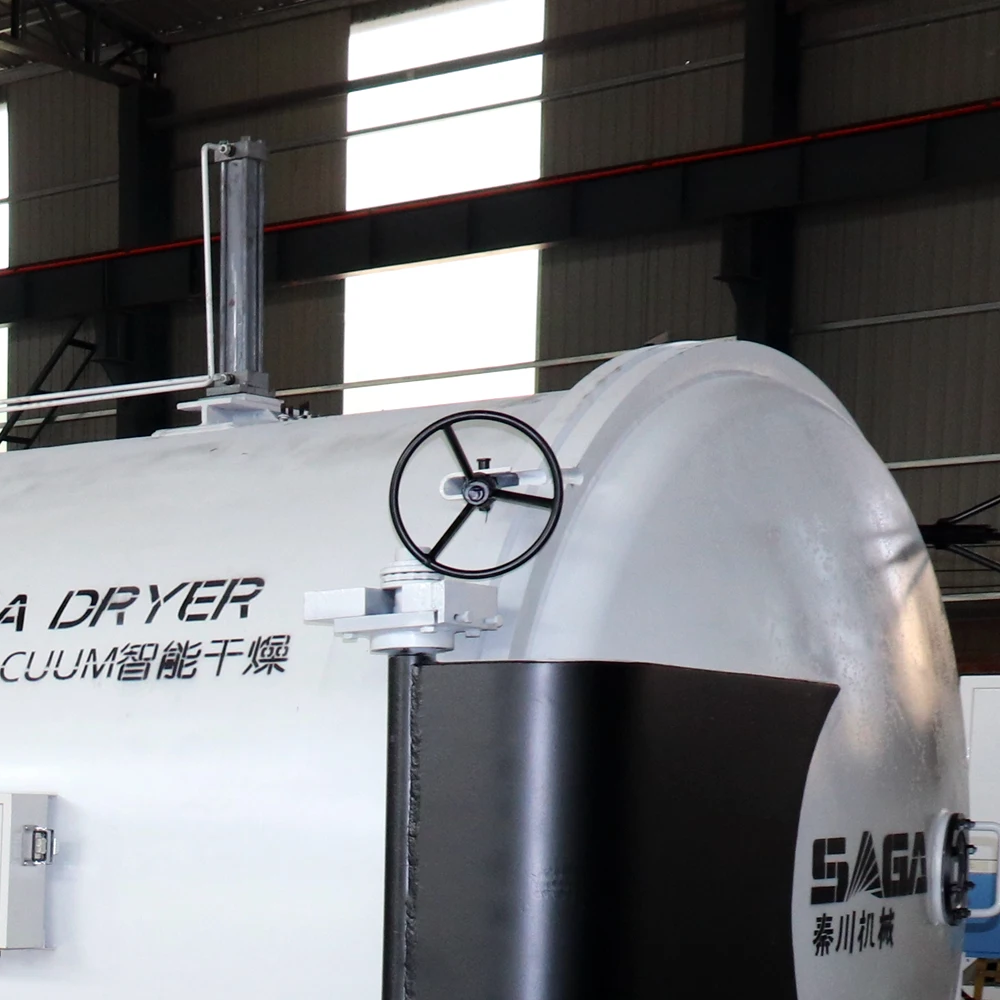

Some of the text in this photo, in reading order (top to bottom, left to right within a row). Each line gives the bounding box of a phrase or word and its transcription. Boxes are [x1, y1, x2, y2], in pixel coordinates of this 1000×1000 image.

[47, 576, 265, 630] DRYER
[810, 830, 928, 905] SAGA
[812, 906, 895, 957] 秦川机械
